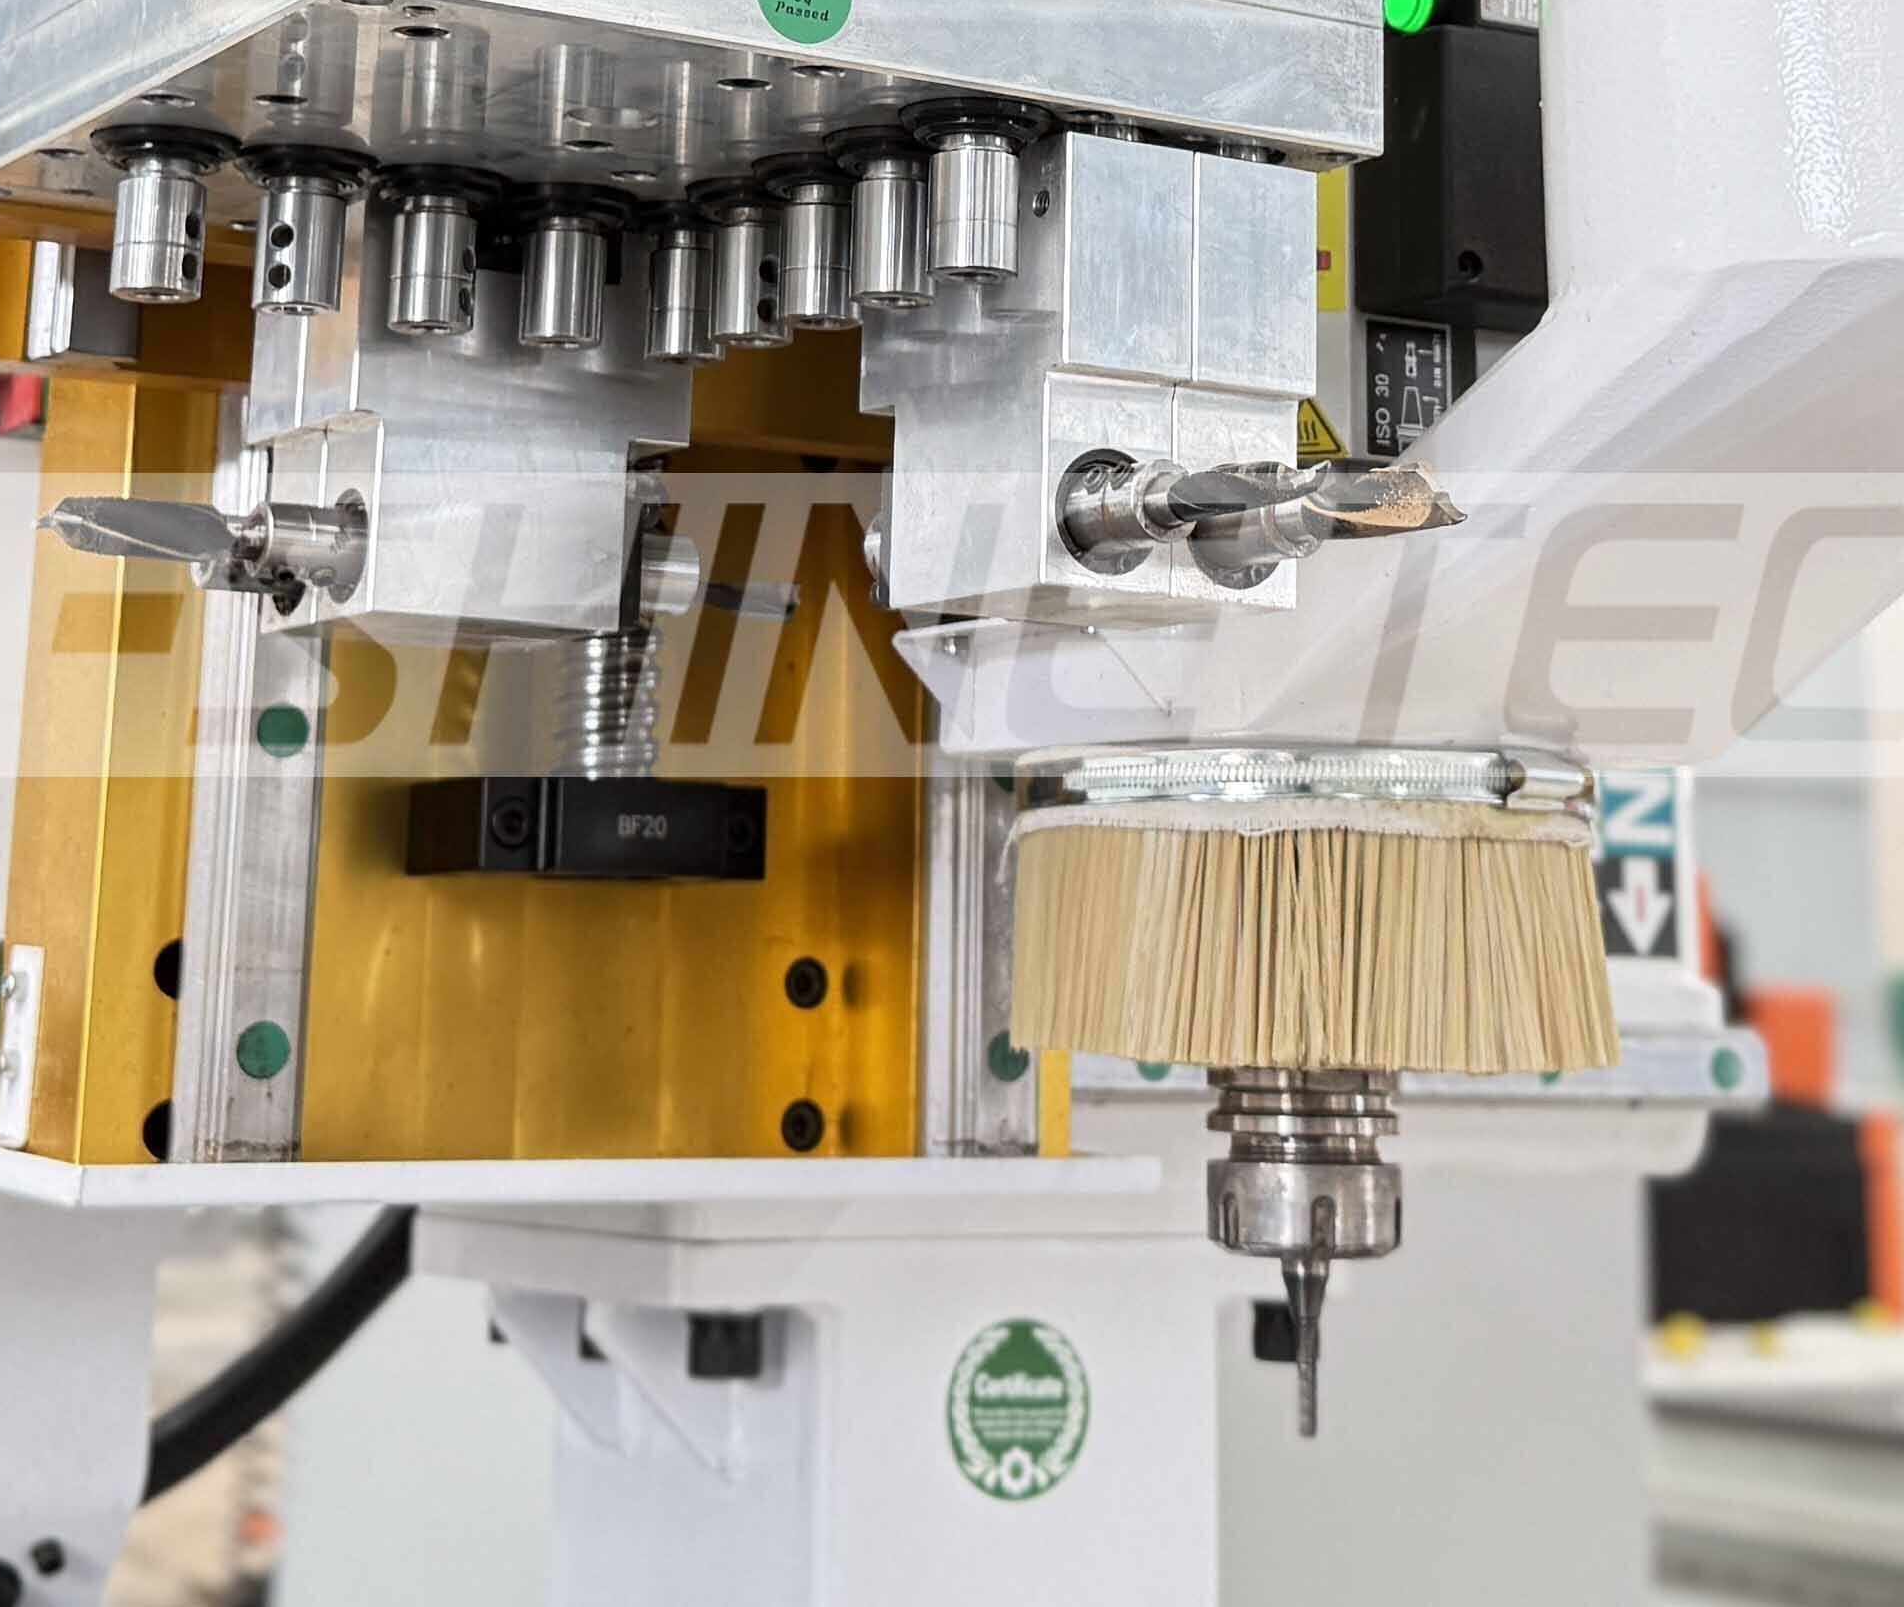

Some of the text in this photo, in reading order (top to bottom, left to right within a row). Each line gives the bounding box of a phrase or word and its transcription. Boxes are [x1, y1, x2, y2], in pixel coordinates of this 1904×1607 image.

[775, 0, 829, 21] Passed
[1375, 373, 1391, 446] ISO 30
[617, 814, 668, 839] BF20
